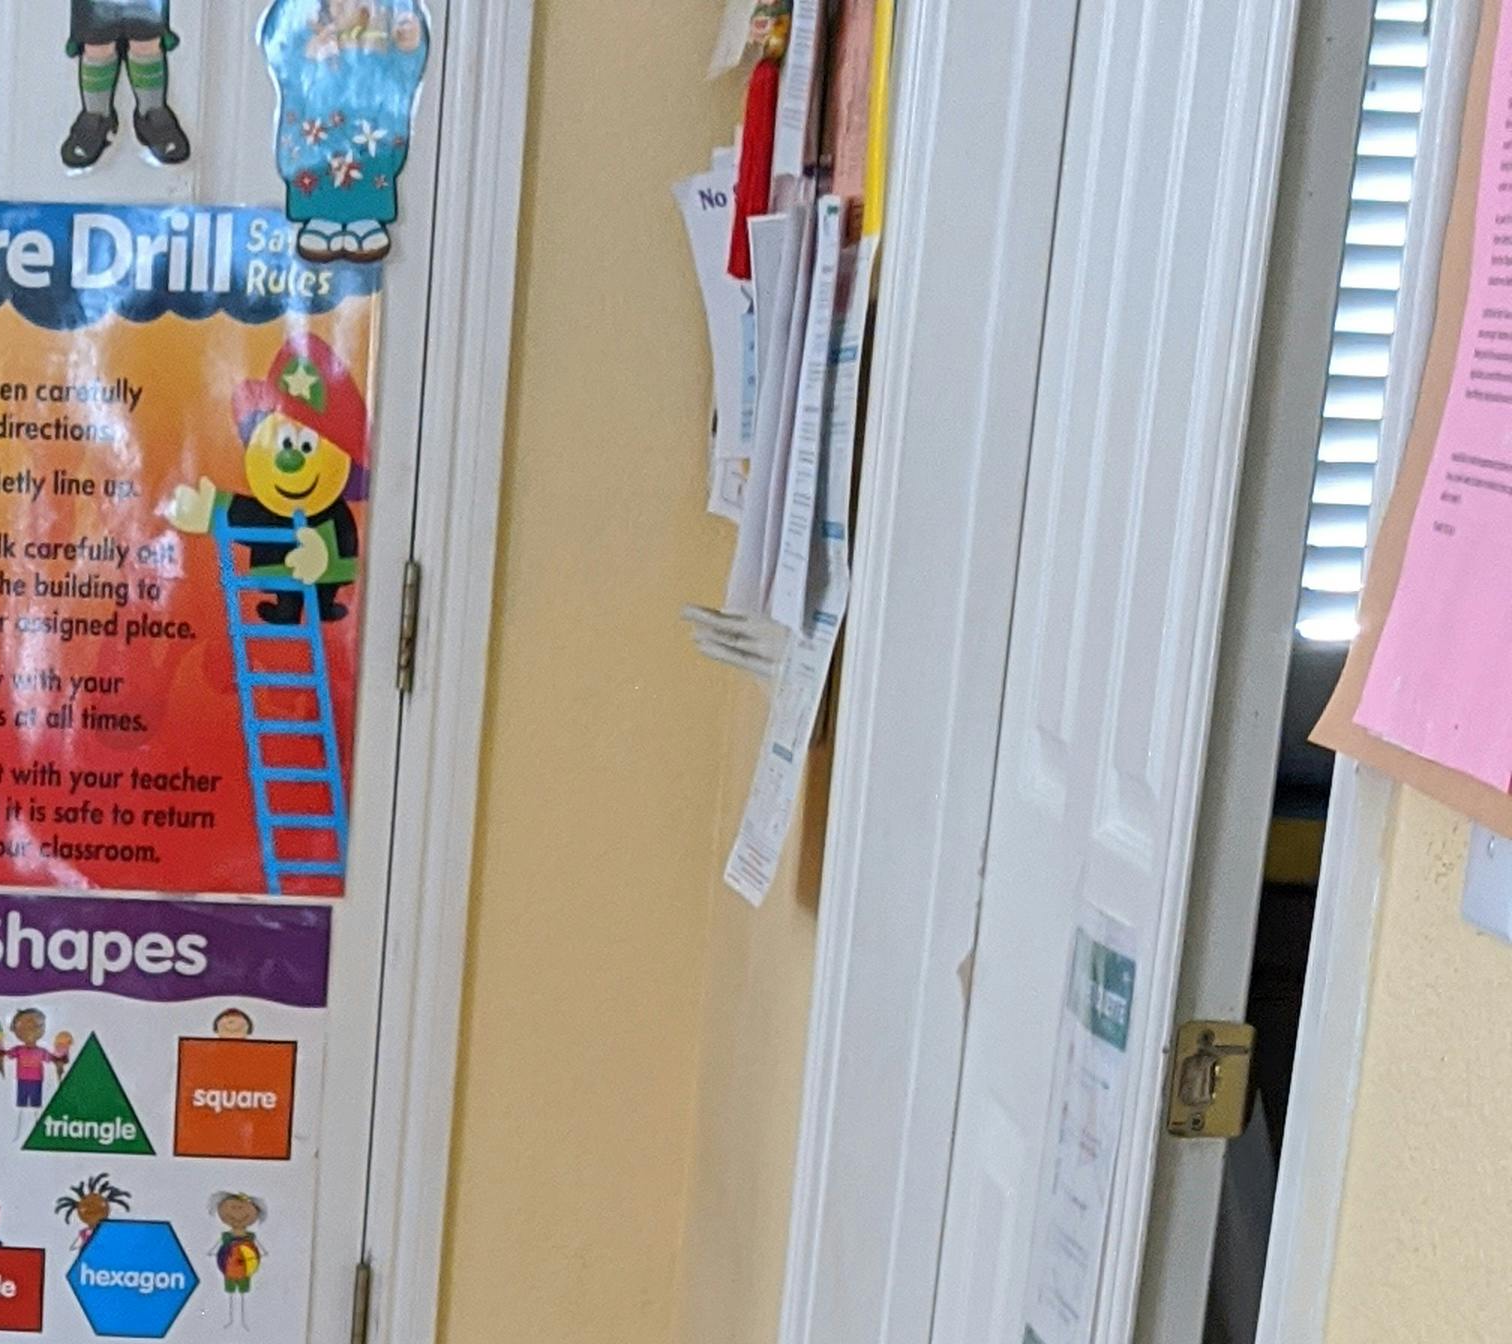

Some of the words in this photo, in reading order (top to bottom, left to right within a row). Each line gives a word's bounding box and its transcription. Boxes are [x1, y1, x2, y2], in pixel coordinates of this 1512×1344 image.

[698, 187, 727, 211] No
[71, 210, 233, 293] Drill
[246, 260, 333, 298] Rules
[36, 377, 143, 412] carefully
[53, 470, 95, 495] line
[24, 536, 130, 567] carefully
[35, 573, 130, 607] building
[137, 579, 161, 600] to
[16, 612, 118, 642] assigned
[125, 613, 196, 643] place.
[70, 677, 124, 699] your
[46, 704, 73, 728] all
[81, 705, 148, 732] times.
[12, 761, 61, 787] with
[70, 770, 123, 794] your
[130, 767, 223, 792] teacher
[6, 798, 22, 821] it
[29, 798, 46, 822] is
[54, 801, 104, 825] safe
[111, 803, 134, 825] to
[142, 806, 215, 829] return
[40, 835, 160, 863] classroom.
[193, 1086, 277, 1112] square
[45, 1115, 137, 1146] triangle
[80, 1263, 185, 1294] hexagon
